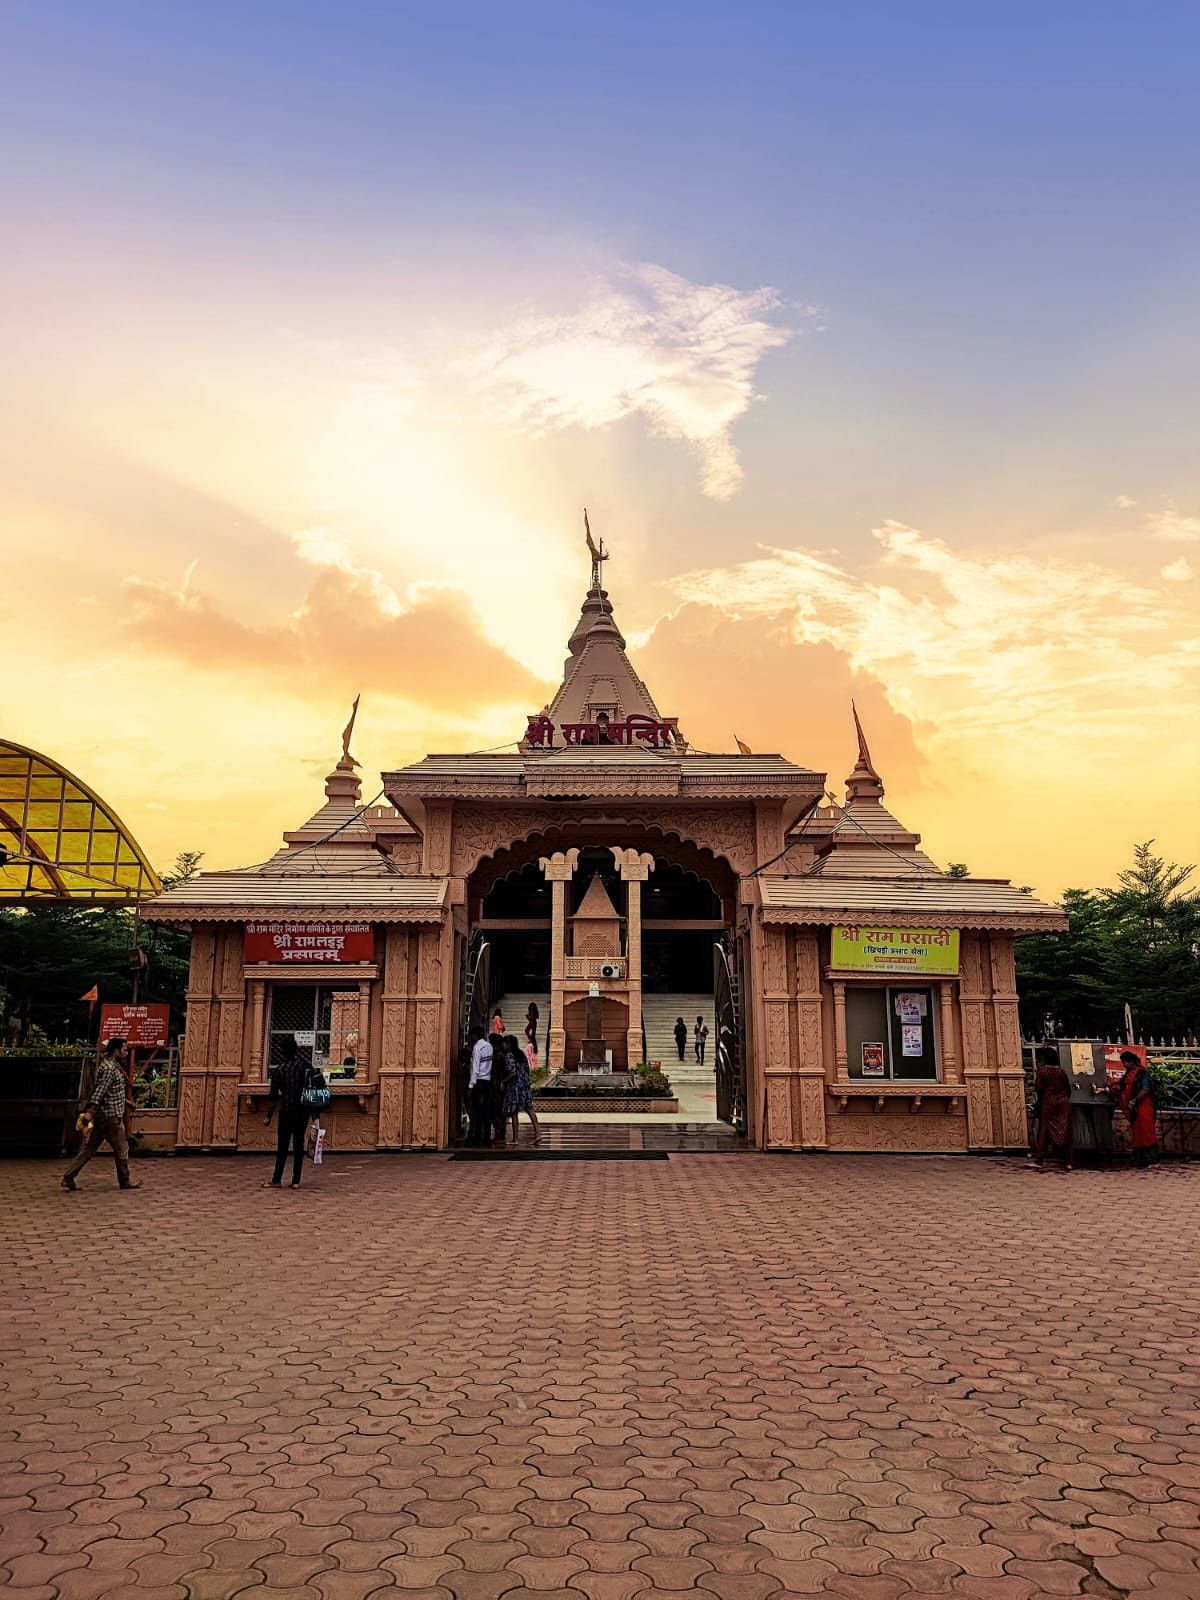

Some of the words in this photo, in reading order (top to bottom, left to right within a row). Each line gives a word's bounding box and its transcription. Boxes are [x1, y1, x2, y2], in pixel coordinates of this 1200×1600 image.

[525, 716, 555, 747] श्री
[560, 723, 600, 746] राम
[606, 714, 673, 746] मन्दिर
[256, 924, 268, 934] राम
[273, 934, 292, 948] श्री
[294, 936, 316, 947] राम
[841, 926, 861, 943] श्री
[865, 930, 895, 944] राम
[900, 929, 951, 947] प्रसादी
[281, 949, 340, 961] प्रसादम्
